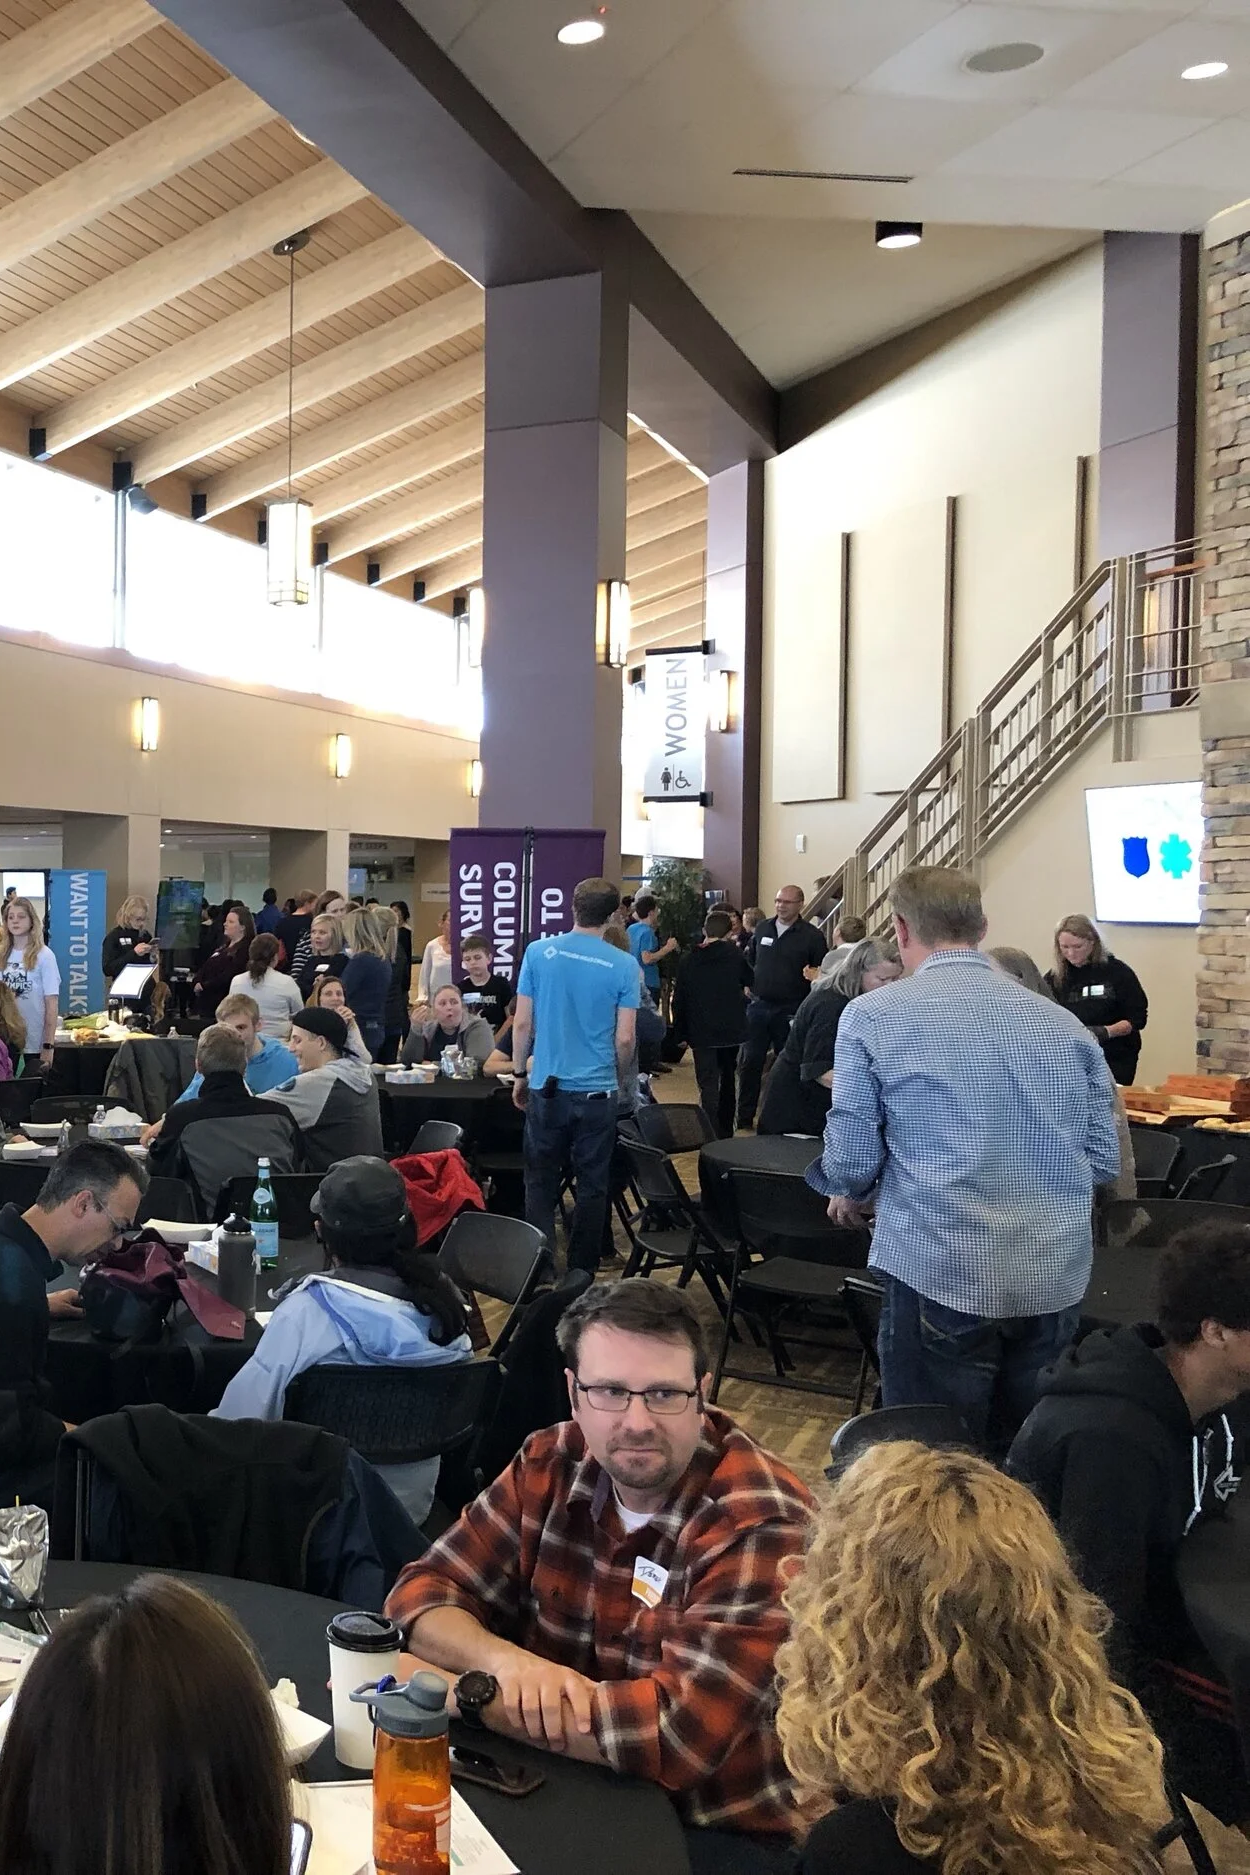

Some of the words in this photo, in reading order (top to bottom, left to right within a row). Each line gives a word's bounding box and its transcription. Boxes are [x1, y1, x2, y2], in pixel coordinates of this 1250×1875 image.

[664, 658, 688, 757] WOMEN
[69, 872, 90, 930] WANT
[540, 887, 564, 925] TO
[69, 933, 90, 957] TO
